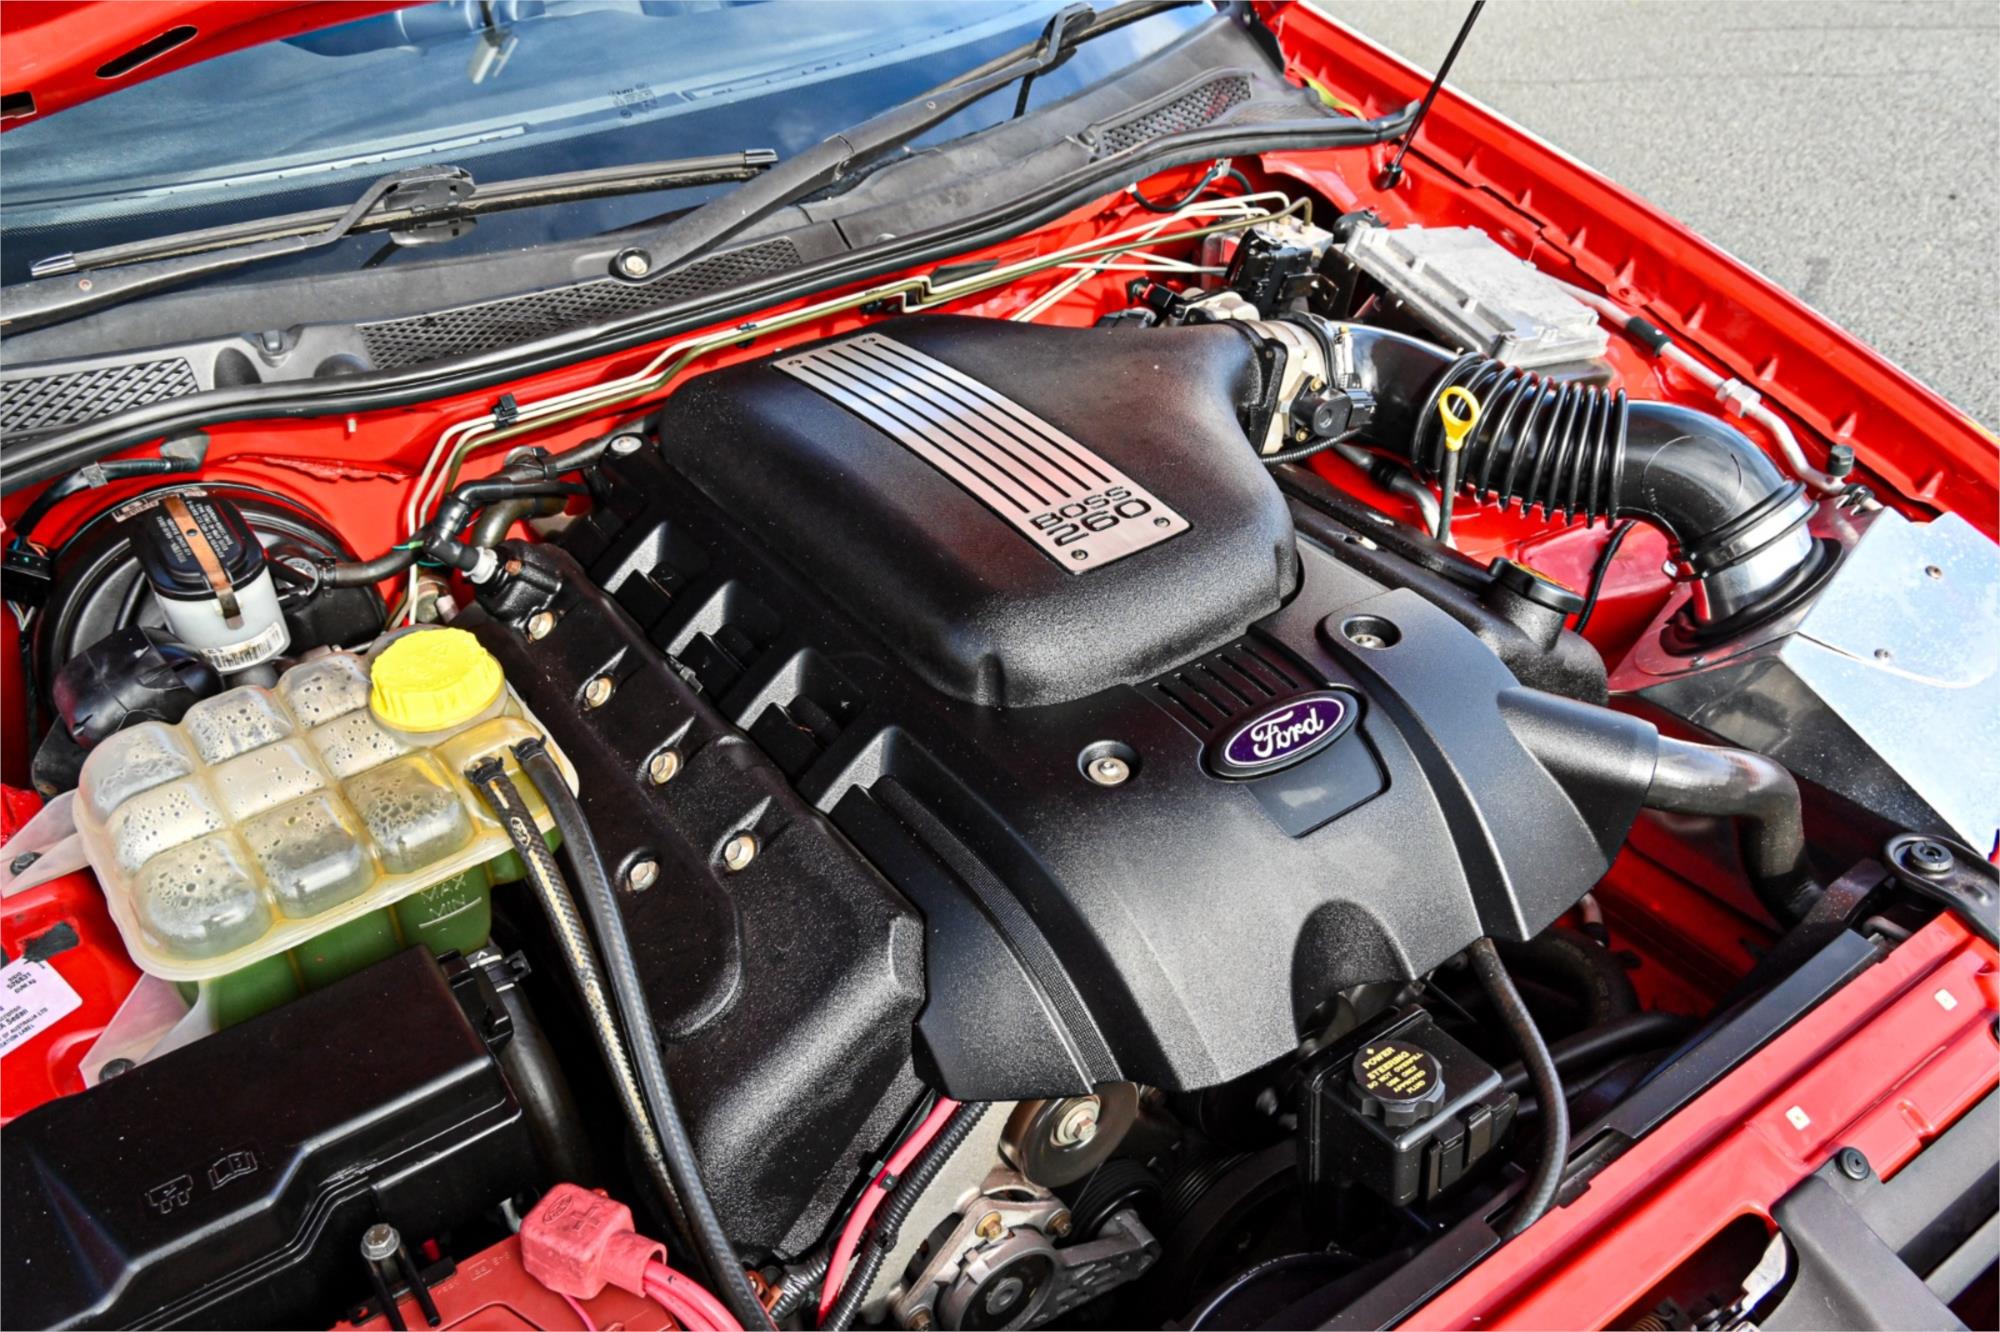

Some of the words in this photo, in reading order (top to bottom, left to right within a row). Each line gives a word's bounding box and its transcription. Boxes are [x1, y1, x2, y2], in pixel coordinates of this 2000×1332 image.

[1029, 486, 1132, 530] BOSS
[1046, 498, 1152, 547] 260
[1250, 706, 1325, 758] Ford
[420, 874, 467, 904] MAX
[428, 894, 466, 919] MIN
[6, 1008, 28, 1025] Sedan
[10, 1013, 38, 1033] AUSTRALIA
[18, 1024, 35, 1036] LABEL
[1362, 1046, 1396, 1069] POWER
[1366, 1051, 1410, 1079] STEERING
[1366, 1080, 1379, 1090] DO
[1378, 1071, 1393, 1082] NOT
[1393, 1052, 1424, 1072] OVERFILL
[1393, 1070, 1426, 1093] APPROVED
[1401, 1064, 1418, 1078] ONLY
[1406, 1080, 1426, 1094] FLUID
